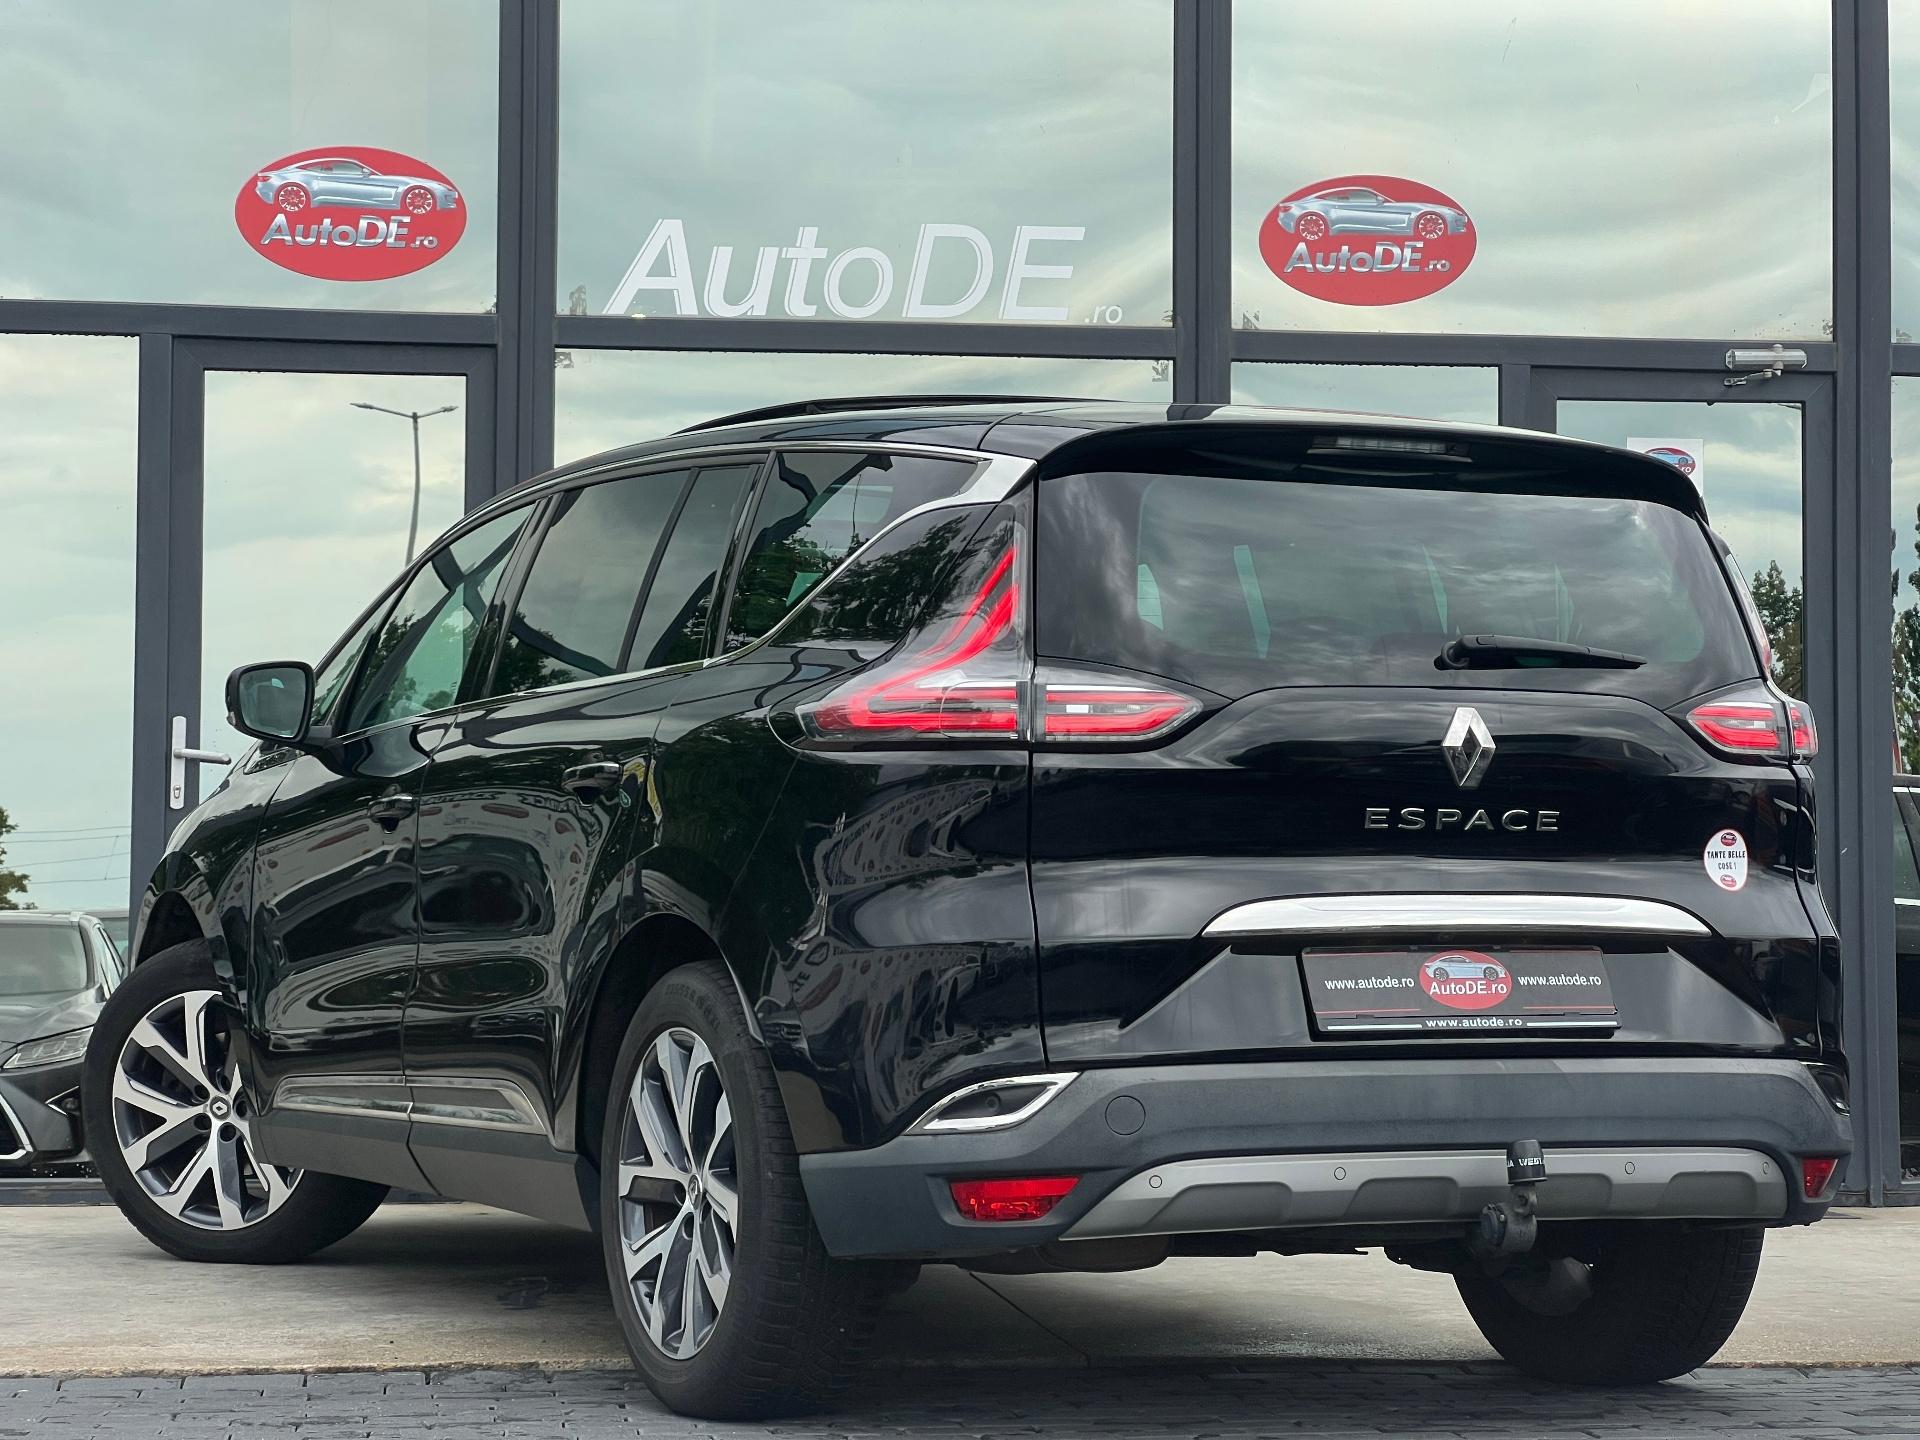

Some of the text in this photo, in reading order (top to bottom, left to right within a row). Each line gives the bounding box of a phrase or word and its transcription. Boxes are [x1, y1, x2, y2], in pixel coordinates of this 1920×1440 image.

[1364, 807, 1561, 832] ESPACE
[1707, 850, 1746, 859] TANTE BELLE
[1718, 861, 1733, 870] COSE
[1324, 975, 1415, 990] www.autode.ro
[1517, 973, 1602, 987] www.autode.ro
[1429, 981, 1508, 996] AutoDE.ro
[1425, 1017, 1523, 1028] www.autode.ro
